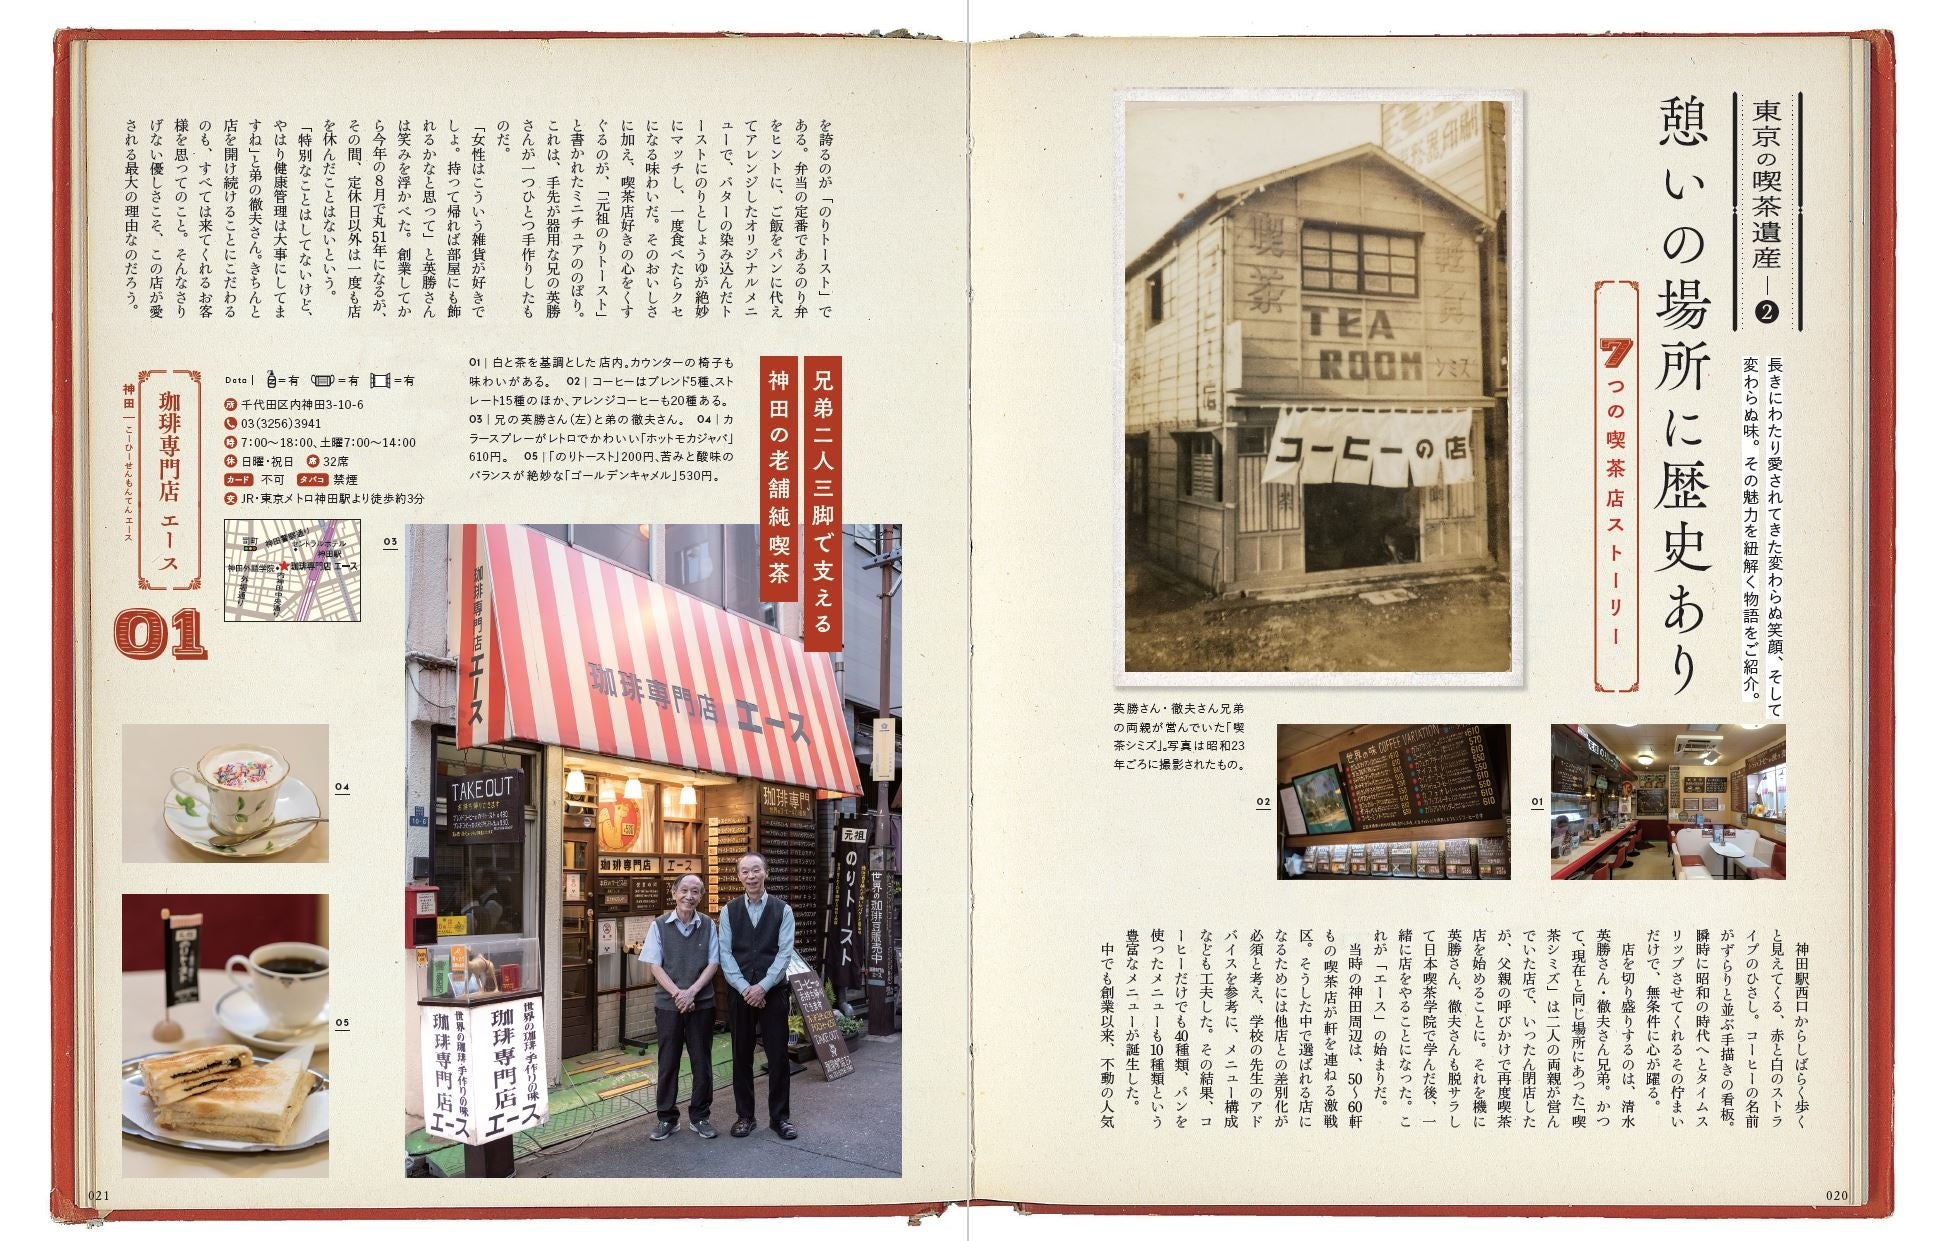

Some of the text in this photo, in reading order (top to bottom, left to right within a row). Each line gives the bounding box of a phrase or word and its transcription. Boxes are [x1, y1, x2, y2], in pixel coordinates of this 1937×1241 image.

[125, 120, 139, 309] される最大の理由なのだろう。
[150, 119, 163, 318] げない優しさこそ、この店が愛
[175, 119, 188, 318] 様を思ってのこと。そんなさり
[199, 121, 212, 318] のも、すべては来てくれるお客
[224, 119, 238, 317] 店を開け続けることにこだわる
[249, 119, 263, 318] すね」と弟の徹夫さん。きちんと
[274, 120, 287, 318] やはり健康管理は大事にしてま
[298, 128, 312, 315] 「特別なことはしてないけど、
[323, 120, 337, 295] を休んだことはないという。
[348, 120, 362, 318] その間、定休日以外は一度も店
[372, 120, 387, 316] ら今年の8月で丸51年になるが、
[398, 120, 411, 317] は笑みを浮かべた。創業してか
[422, 120, 436, 318] れるかなと思って」と英勝さん
[447, 120, 461, 318] しょ。持って帰れば部屋にも飾
[472, 128, 486, 317] 「女性はこういう雑貨が好きで
[497, 121, 510, 152] のだ。
[522, 120, 535, 318] さんが一つひとつ手作りしたも
[546, 121, 560, 318] これは、手先が器用な兄の英勝
[596, 120, 610, 316] ぐるのが、「元祖のりトースト」
[621, 120, 635, 318] に加え、喫茶店好きの心をくす
[646, 120, 659, 318] になる味わいだ。そのおいしさ
[671, 120, 684, 317] にマッチし、一度食べたらクセ
[695, 120, 709, 318] ーストにのりとしょうゆが絶妙
[720, 123, 733, 317] ューで、バターの染み込んだト
[746, 121, 758, 315] てアレンジしたオリジナルメニ
[770, 120, 783, 317] をヒントに、ご飯をパンに代え
[794, 119, 808, 318] ある。弁当の定番であるのり弁
[819, 120, 833, 317] を誇るのが「のりトースト」で
[1752, 100, 1782, 268] 東京の喫茶遺産
[241, 399, 363, 410] 千代田区内神田3-10-6
[470, 376, 549, 387] 味わいがある。
[471, 395, 726, 406] レート15種のほか、アレンジコーヒーも20種ある。
[1302, 305, 1395, 339] TEA
[1320, 349, 1423, 382] ROOM
[1654, 95, 1712, 695] 憩いの場所に歴史あり
[123, 384, 135, 541] 神田 こーひーせんもんてん エース
[159, 391, 181, 570] 珈琲専門店 エース
[227, 474, 357, 485] カード 不可 タバコ 禁煙
[242, 418, 320, 429] 03(3256)3941
[242, 493, 424, 504] JR・東京メトロ神田駅より徒歩約3分
[243, 456, 292, 467] 日曜・祝日
[324, 456, 348, 467] 32席
[470, 452, 507, 462] 610円。
[470, 470, 718, 481] バランスが絶妙な「ゴールデンキャメル」530円。
[769, 371, 790, 583] 神田の老舗純喫茶
[813, 371, 834, 632] 兄弟二人三脚で支える
[1275, 435, 1468, 463] コーヒーの店
[1600, 338, 1633, 644] 7つの喫茶店ストーリー
[291, 562, 357, 571] 珈琲専門店 エース
[318, 550, 341, 558] 神田駅
[1743, 357, 1759, 698] 変わらぬ味。その魅力を紐解く物語をご紹介。
[1768, 358, 1783, 716] 長きにわたり愛されてきた変わらぬ笑顔、そして
[114, 608, 208, 660] 01
[467, 565, 485, 726] 珈琲専門店 エース
[587, 661, 812, 746] 珈琲専門店 エース
[1114, 703, 1244, 714] 英勝さん・徹夫さん兄弟
[1114, 722, 1244, 733] の両親が営んでいた「喫
[763, 786, 811, 812] 珈琲専門
[1114, 740, 1244, 751] 茶シミズ」。写真は昭和23
[1114, 759, 1243, 770] 年ごろに撮影されたもの。
[1346, 745, 1377, 764] 世界の味
[1468, 735, 1482, 745] 570
[1470, 744, 1484, 755] 610
[1474, 762, 1488, 772] 550
[1476, 771, 1489, 780] 610
[1479, 779, 1491, 788] 550
[1480, 788, 1494, 797] 610
[1482, 796, 1496, 806] 610
[600, 859, 692, 871] 珈琲専門店 エース
[840, 850, 857, 966] のりトースト
[844, 829, 866, 842] 元祖
[433, 1013, 452, 1113] 珈琲専門店
[491, 1008, 517, 1110] 珈琲専門店
[1100, 943, 1114, 1128] 中でも創業以来、不動の人気
[1126, 929, 1139, 1105] 豊富なメニューが誕生した。
[1151, 929, 1164, 1127] 使ったメニューも10種類という
[1175, 930, 1189, 1128] ーヒーだけでも40種類、パンを
[1200, 929, 1213, 1125] なども工夫した。その結果、コ
[1225, 930, 1239, 1128] バイスを参考に、メニュー構成
[1250, 929, 1263, 1127] 必須と考え、学校の先生のアド
[1275, 929, 1288, 1127] なるためには他店との差別化が
[1299, 929, 1313, 1127] 区。そうした中で選ばれる店に
[1324, 929, 1338, 1128] もの喫茶店が軒を連ねる激戦
[1374, 930, 1387, 1105] れが「エース」の始まりだ。
[1399, 929, 1412, 1127] 緒に店をやることになった。こ
[1423, 931, 1437, 1122] て日本喫茶学院で学んだ後、一
[1448, 929, 1462, 1128] 英勝さん、徹夫さんも脱サラし
[1473, 929, 1486, 1127] 店を始めることに。それを機に
[1497, 929, 1511, 1128] が、父親の呼びかけで再度喫茶
[1523, 931, 1536, 1128] でいた店で、いったん閉店した
[1547, 929, 1561, 1128] 茶シミズ」は二人の両親が営ん
[1572, 930, 1586, 1128] て、現在と同じ場所にあった「喫
[1597, 929, 1611, 1125] 英勝さん・徹夫さん兄弟。かつ
[1622, 943, 1635, 1128] 店を切り盛りするのは、清水
[1646, 930, 1660, 1105] だけで、無条件に心が躍る。
[1671, 931, 1684, 1127] リップさせてくれるその佇まい
[1696, 929, 1710, 1126] 瞬時に昭和の時代へとタイムス
[1721, 930, 1734, 1126] がずらりと並ぶ手描きの看板。
[1746, 930, 1759, 1128] イプのひさし。コーヒーの名前
[1771, 930, 1784, 1127] と見えてくる、赤と白のストラ
[1795, 942, 1809, 1128] 神田駅西口からしばらく歩く
[89, 1189, 108, 1202] 021
[430, 1112, 470, 1138] エース
[485, 1103, 541, 1138] エース
[1827, 1191, 1848, 1200] 020
